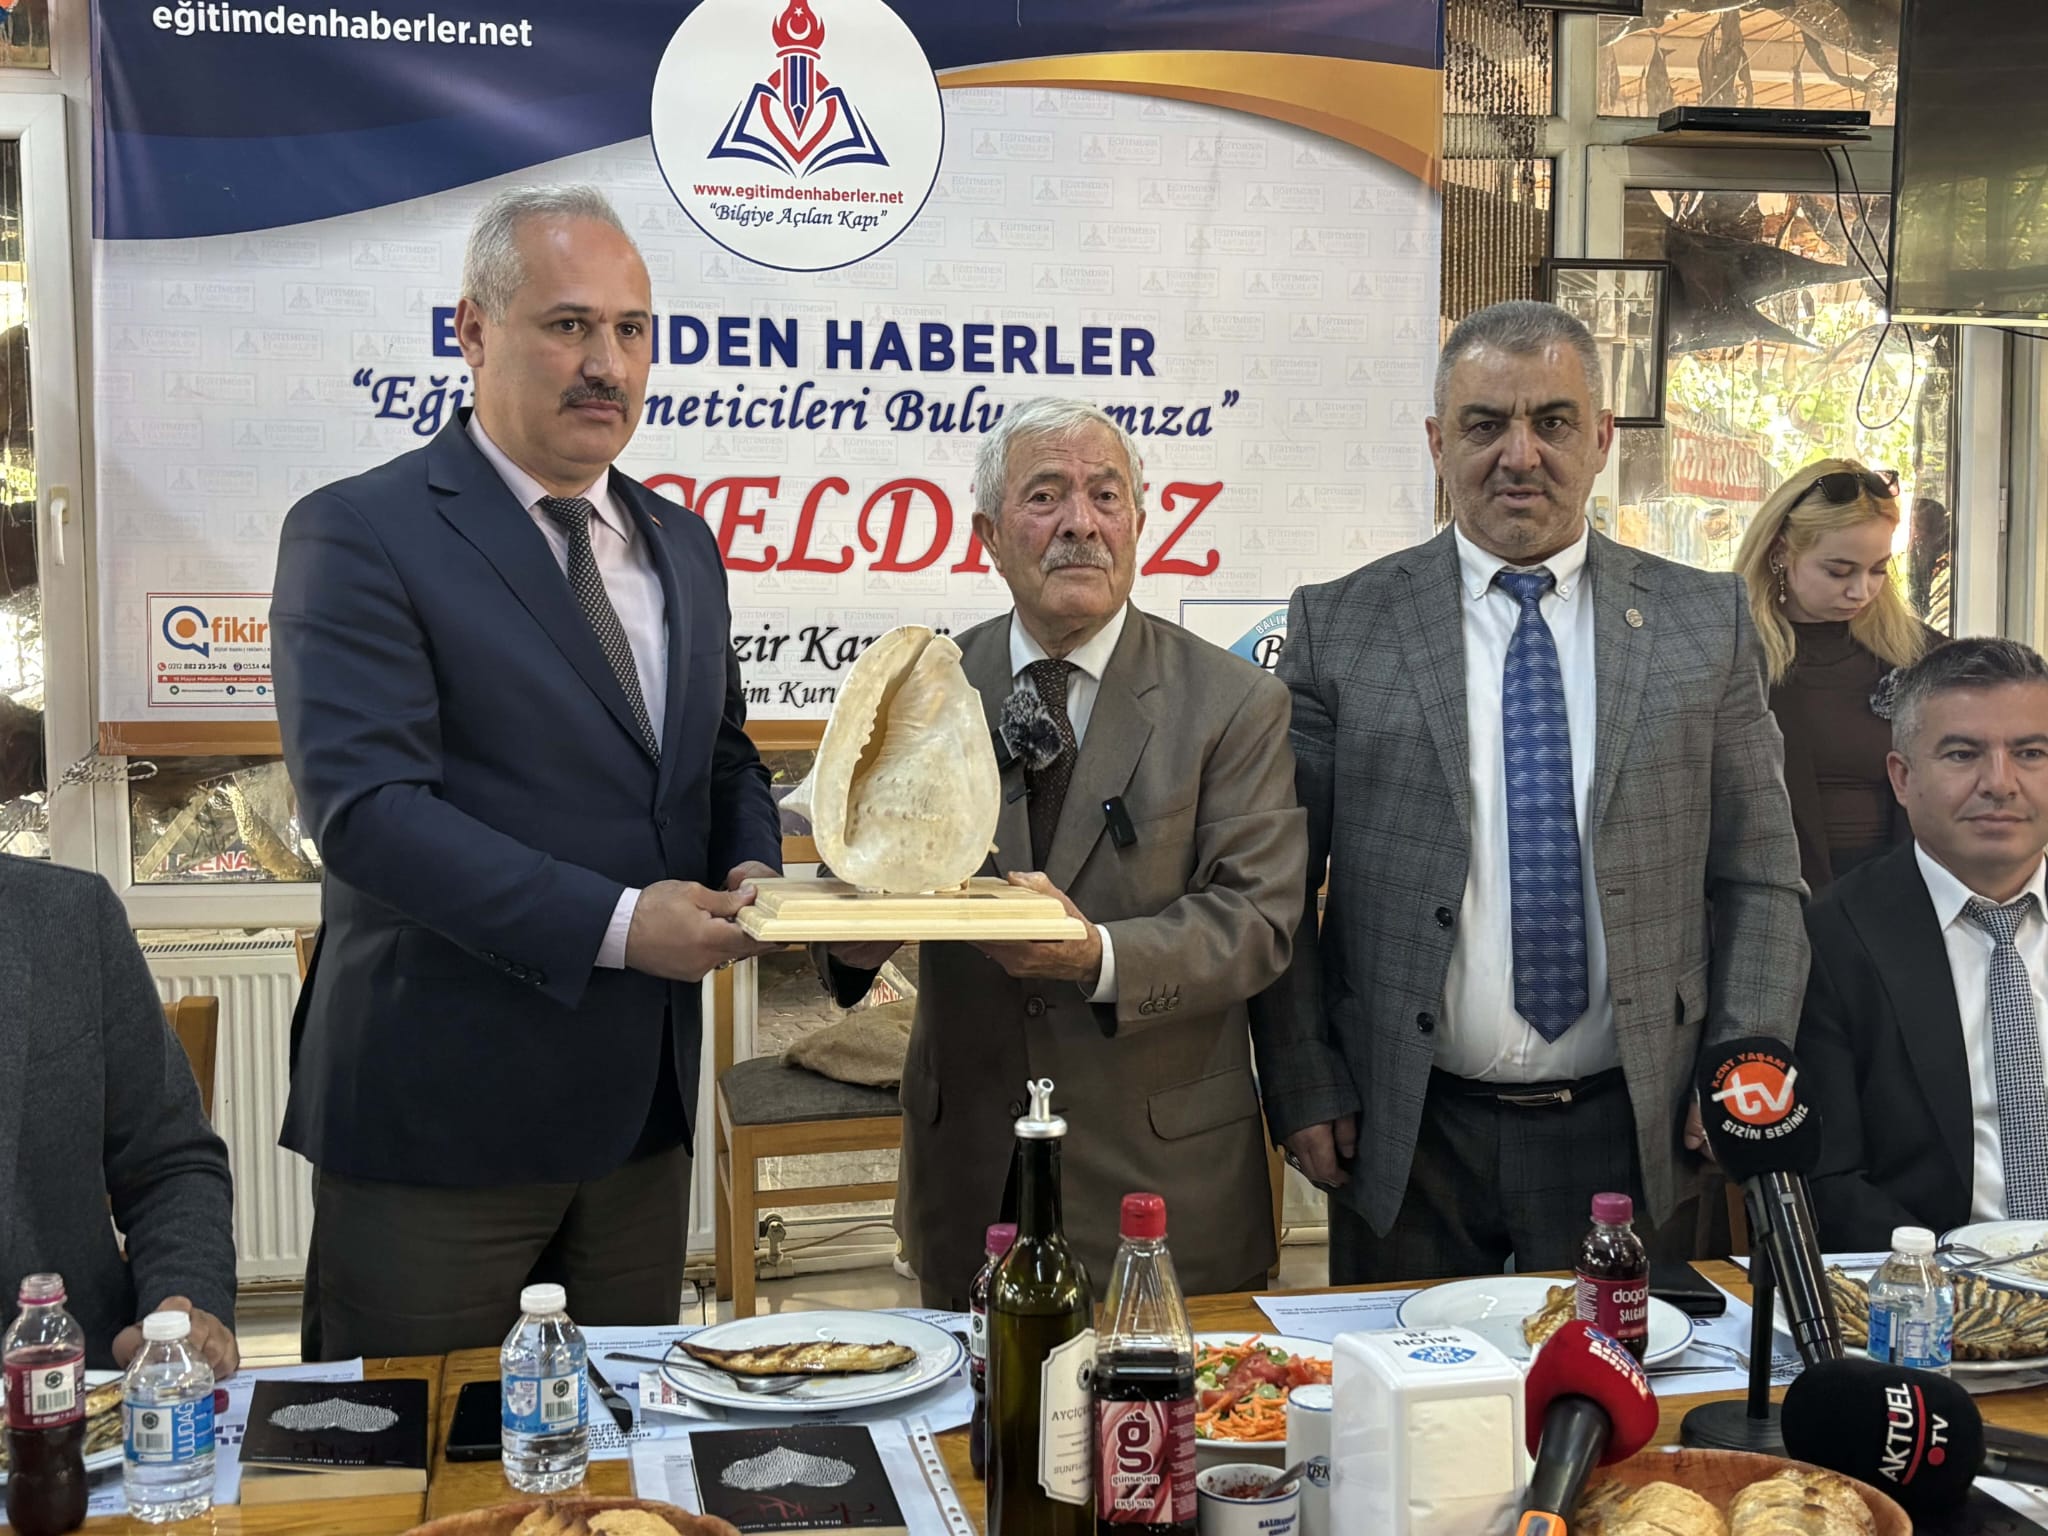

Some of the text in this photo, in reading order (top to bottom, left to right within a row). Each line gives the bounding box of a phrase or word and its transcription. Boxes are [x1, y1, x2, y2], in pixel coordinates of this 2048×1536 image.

[152, 2, 533, 47] eğitimdenhaberler.net
[693, 184, 904, 204] www.egitimdenhaberler.net
[777, 207, 833, 230] Açılan
[826, 319, 1156, 377] HABERLER
[645, 381, 870, 431] neticileri
[1878, 1383, 1915, 1483] AKTÜEL
[1931, 1414, 1949, 1446] TV
